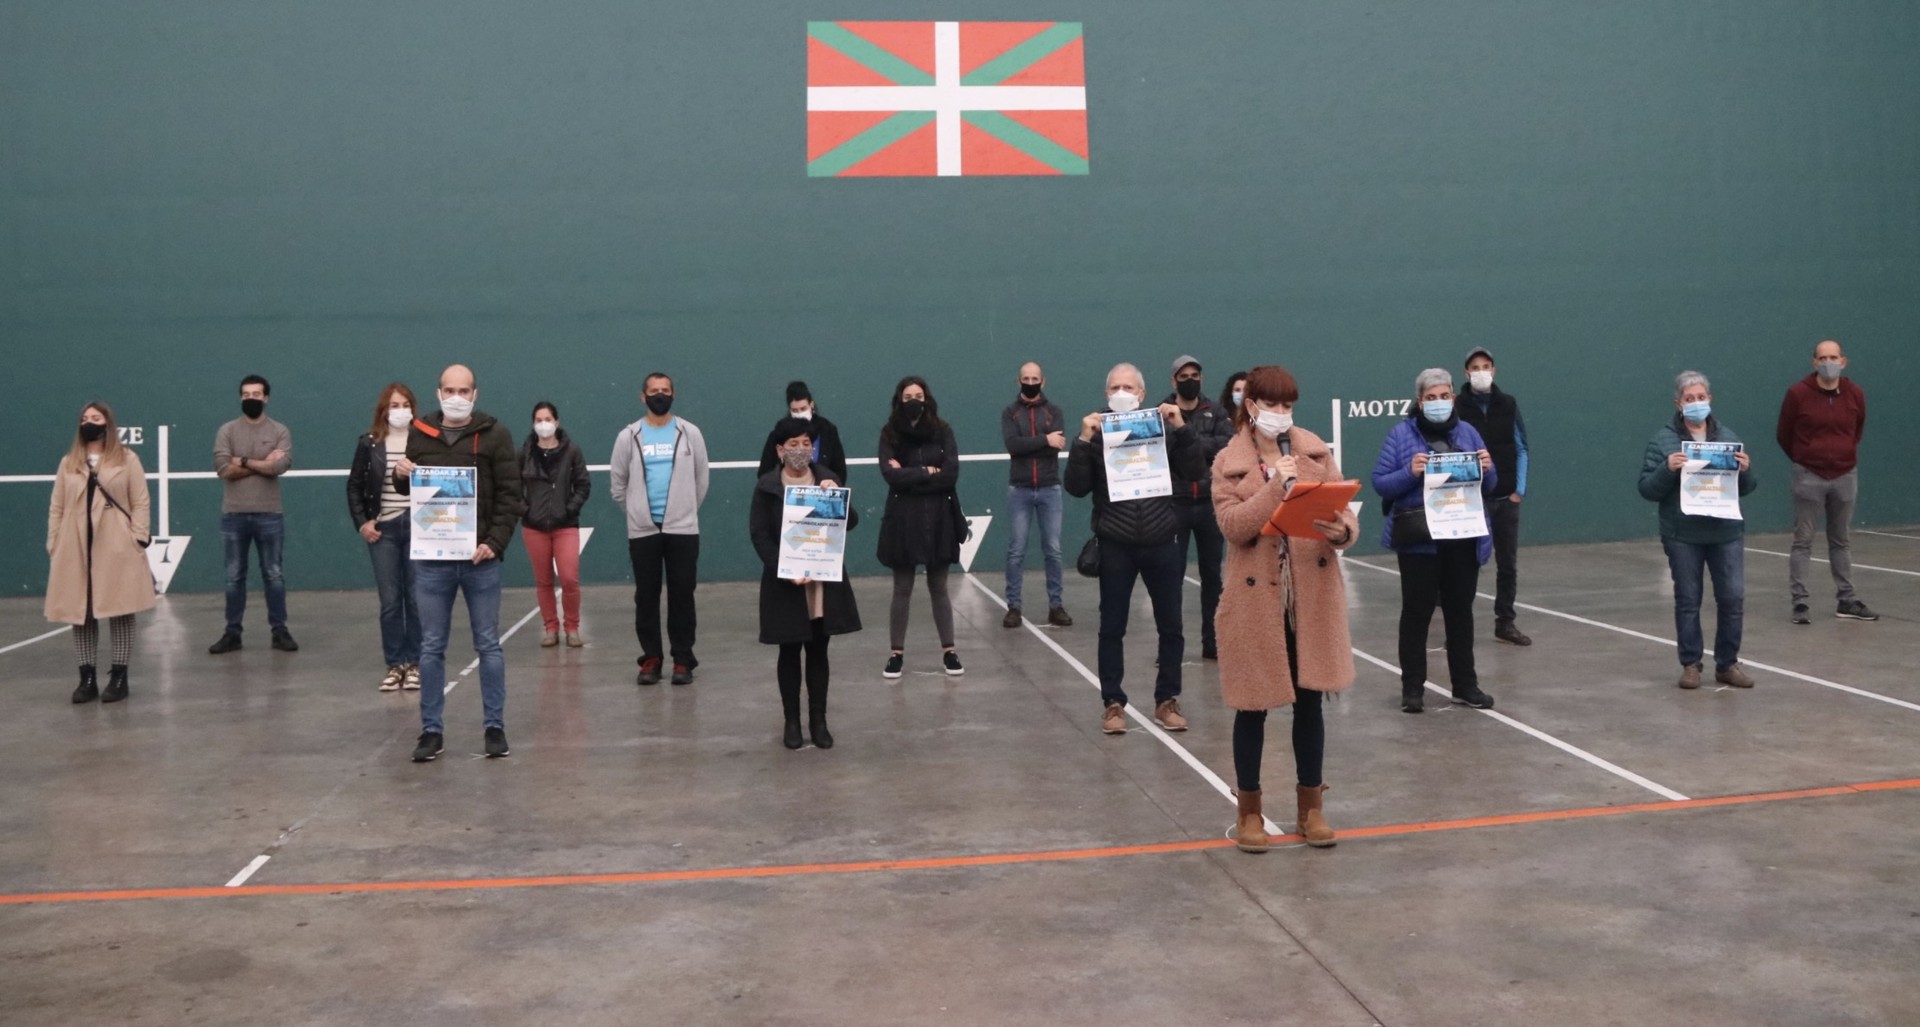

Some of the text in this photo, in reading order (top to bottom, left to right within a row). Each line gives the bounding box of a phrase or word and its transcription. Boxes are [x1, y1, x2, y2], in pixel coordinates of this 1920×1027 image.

[1348, 399, 1412, 418] MOTZ
[117, 427, 144, 445] ZE
[154, 538, 172, 564] 7
